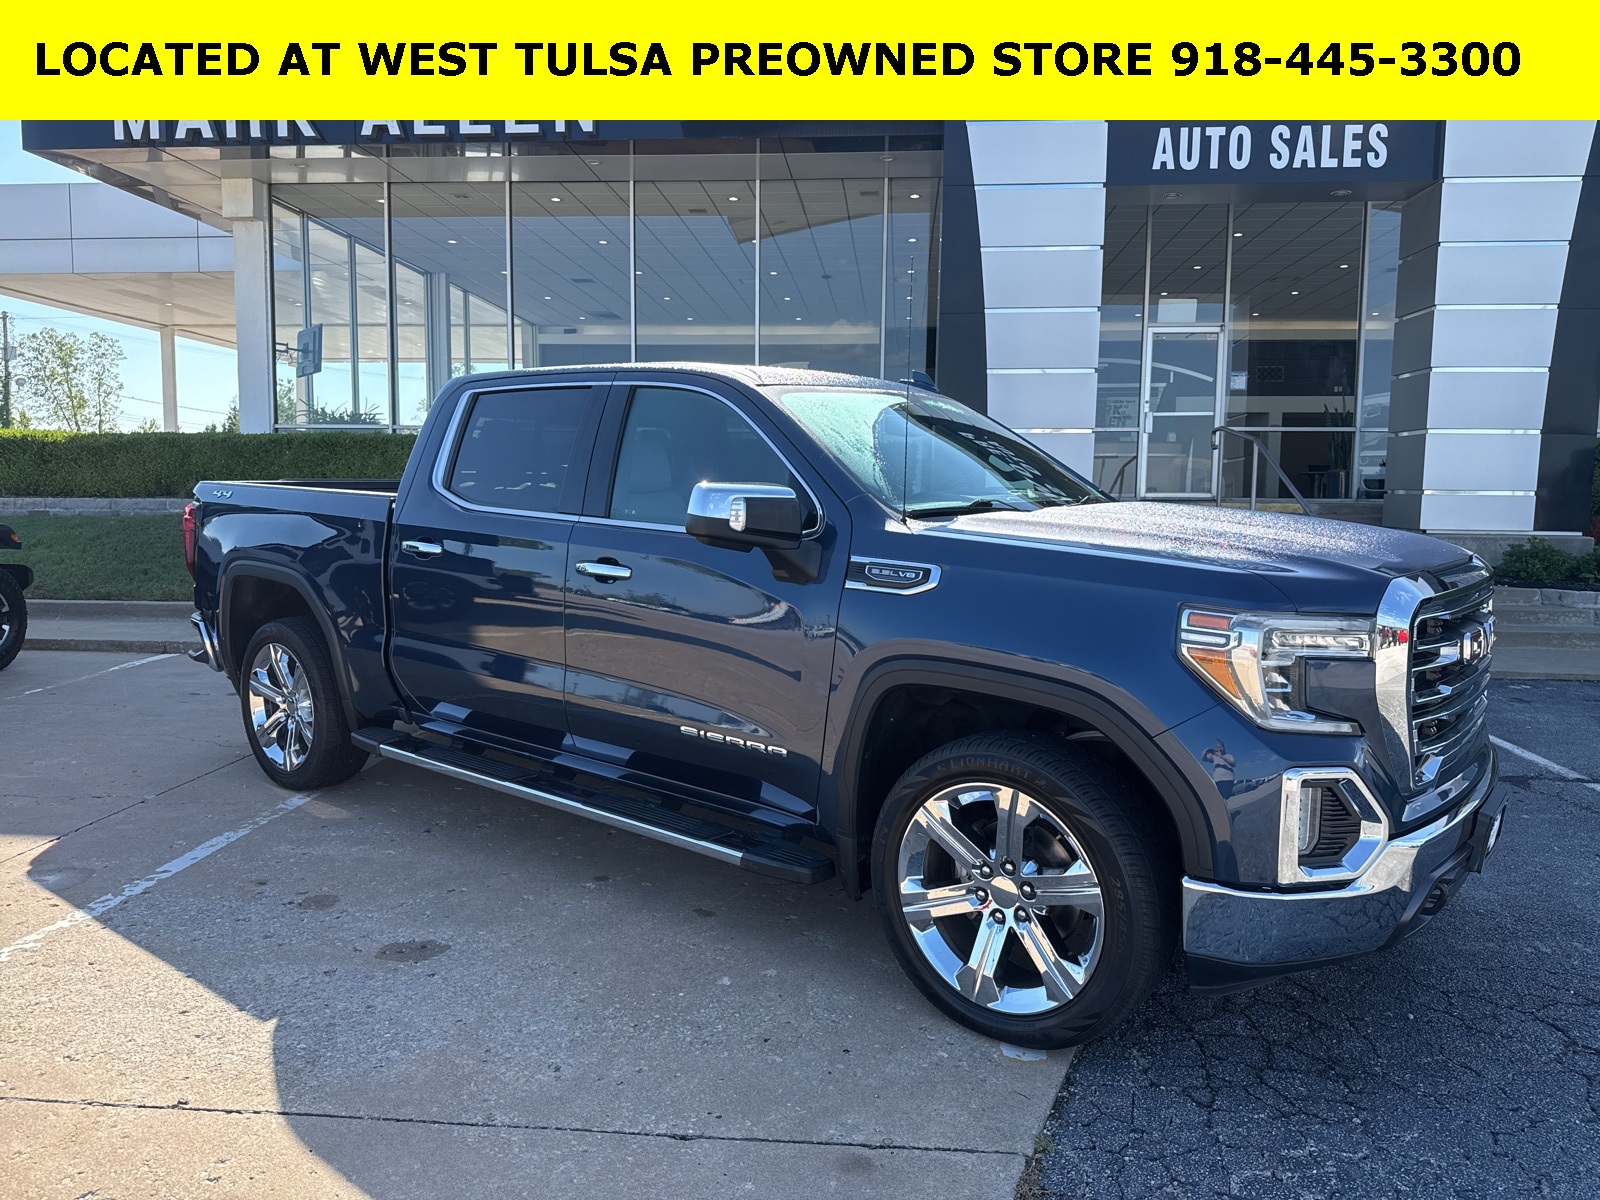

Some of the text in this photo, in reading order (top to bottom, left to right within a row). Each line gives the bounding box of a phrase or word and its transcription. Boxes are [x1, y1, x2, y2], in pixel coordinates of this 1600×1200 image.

[1152, 123, 1389, 170] AUTO SALES
[680, 725, 788, 758] SIERRA
[949, 757, 1032, 779] LIONHART
